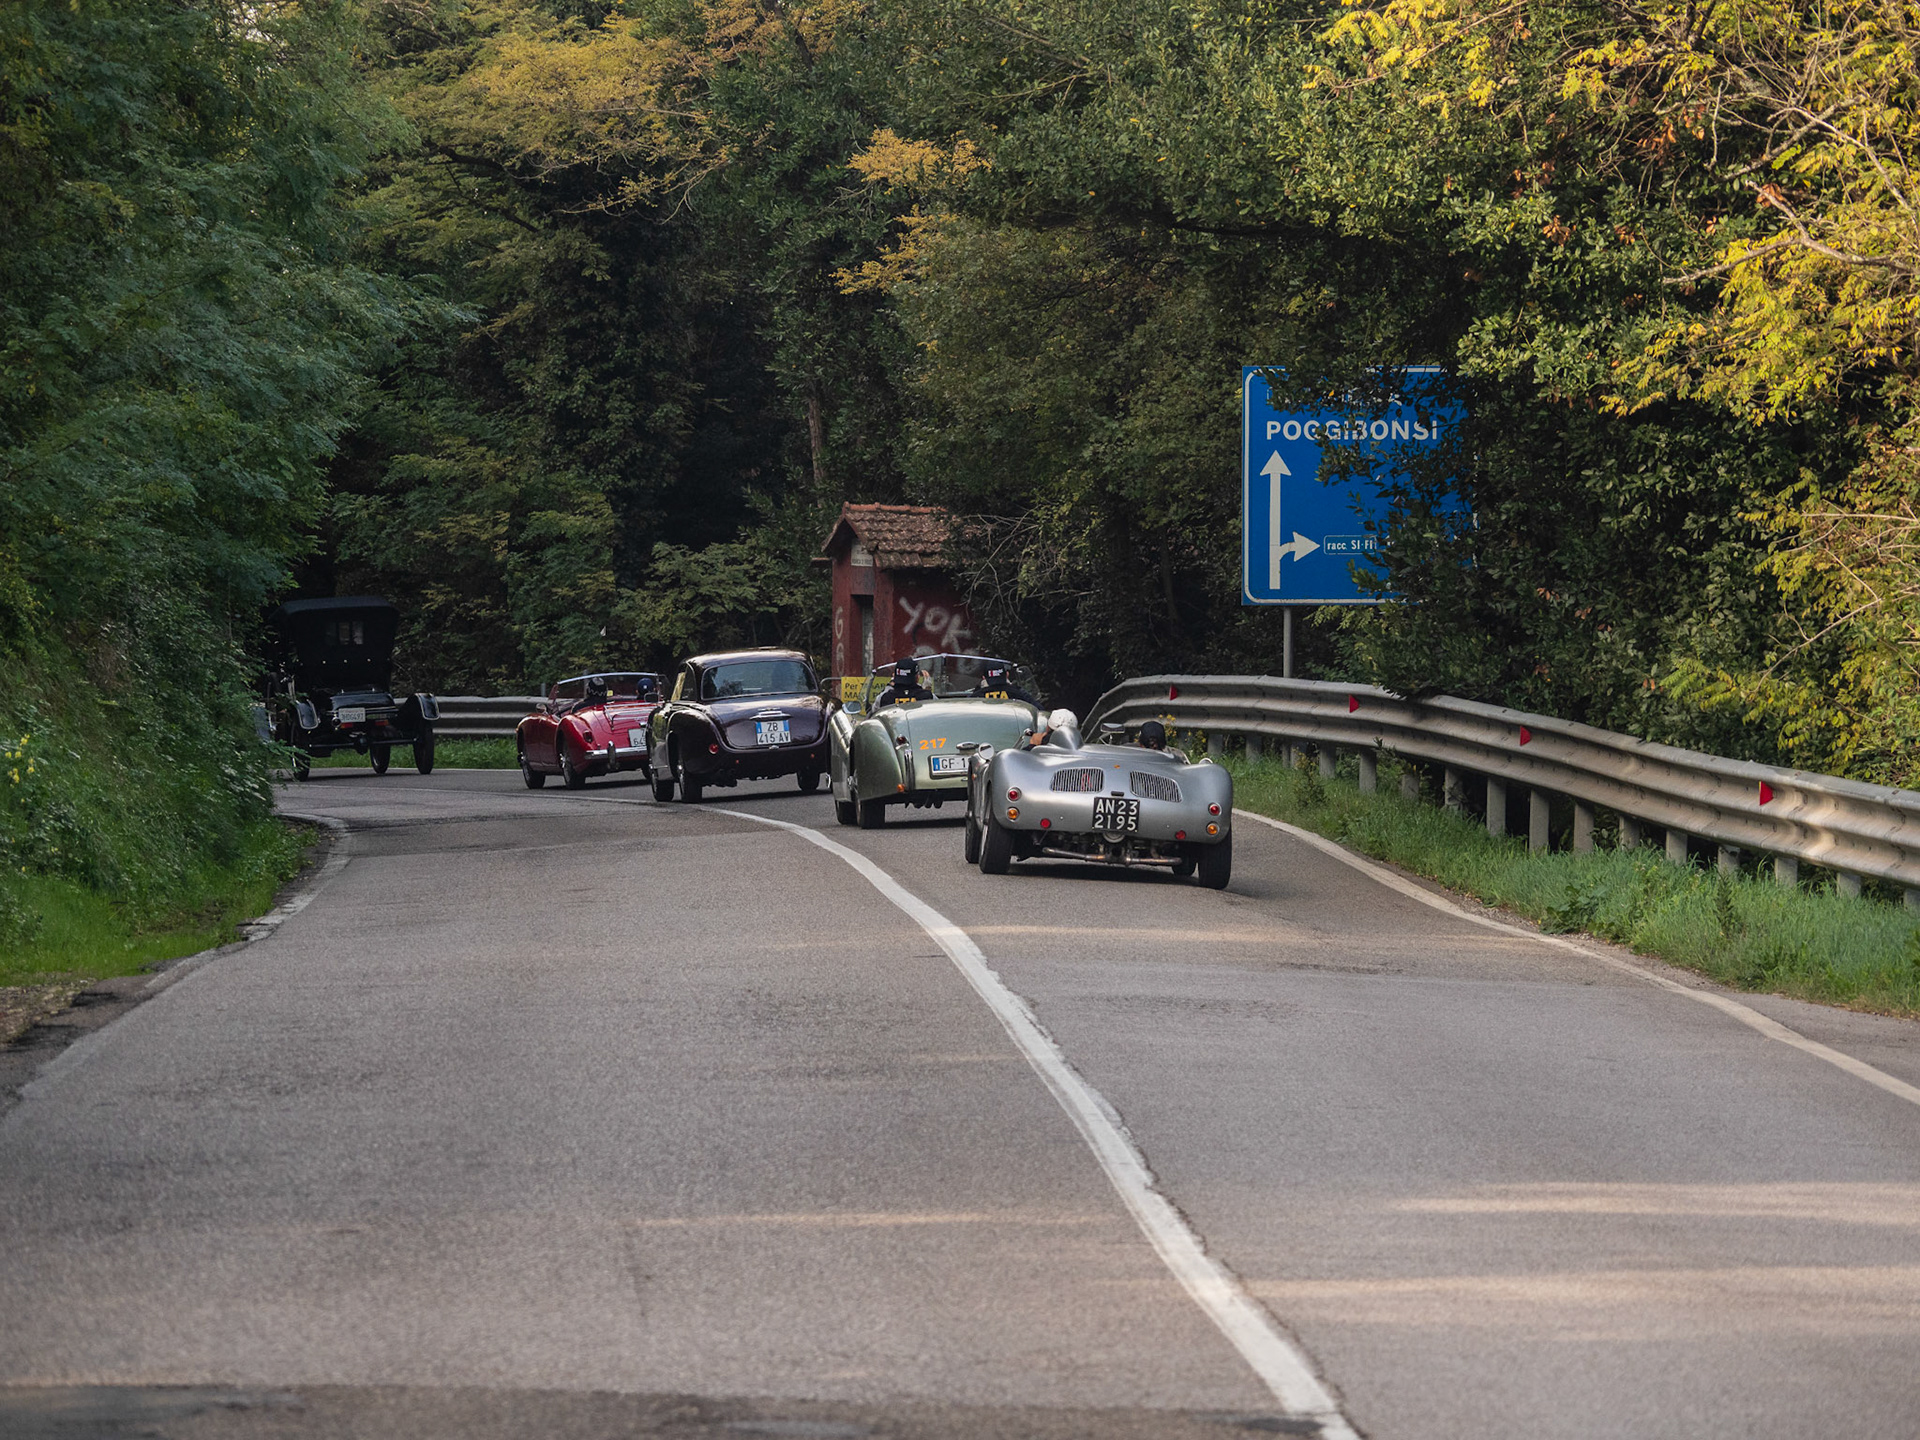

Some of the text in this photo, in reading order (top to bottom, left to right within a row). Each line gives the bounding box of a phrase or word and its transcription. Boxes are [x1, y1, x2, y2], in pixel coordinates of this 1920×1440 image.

[1266, 420, 1438, 440] POGGIBONSI
[766, 722, 779, 732] ZB
[758, 732, 790, 743] 415 AV
[919, 737, 947, 751] 217
[941, 758, 955, 769] GF
[1094, 814, 1137, 831] 2195
